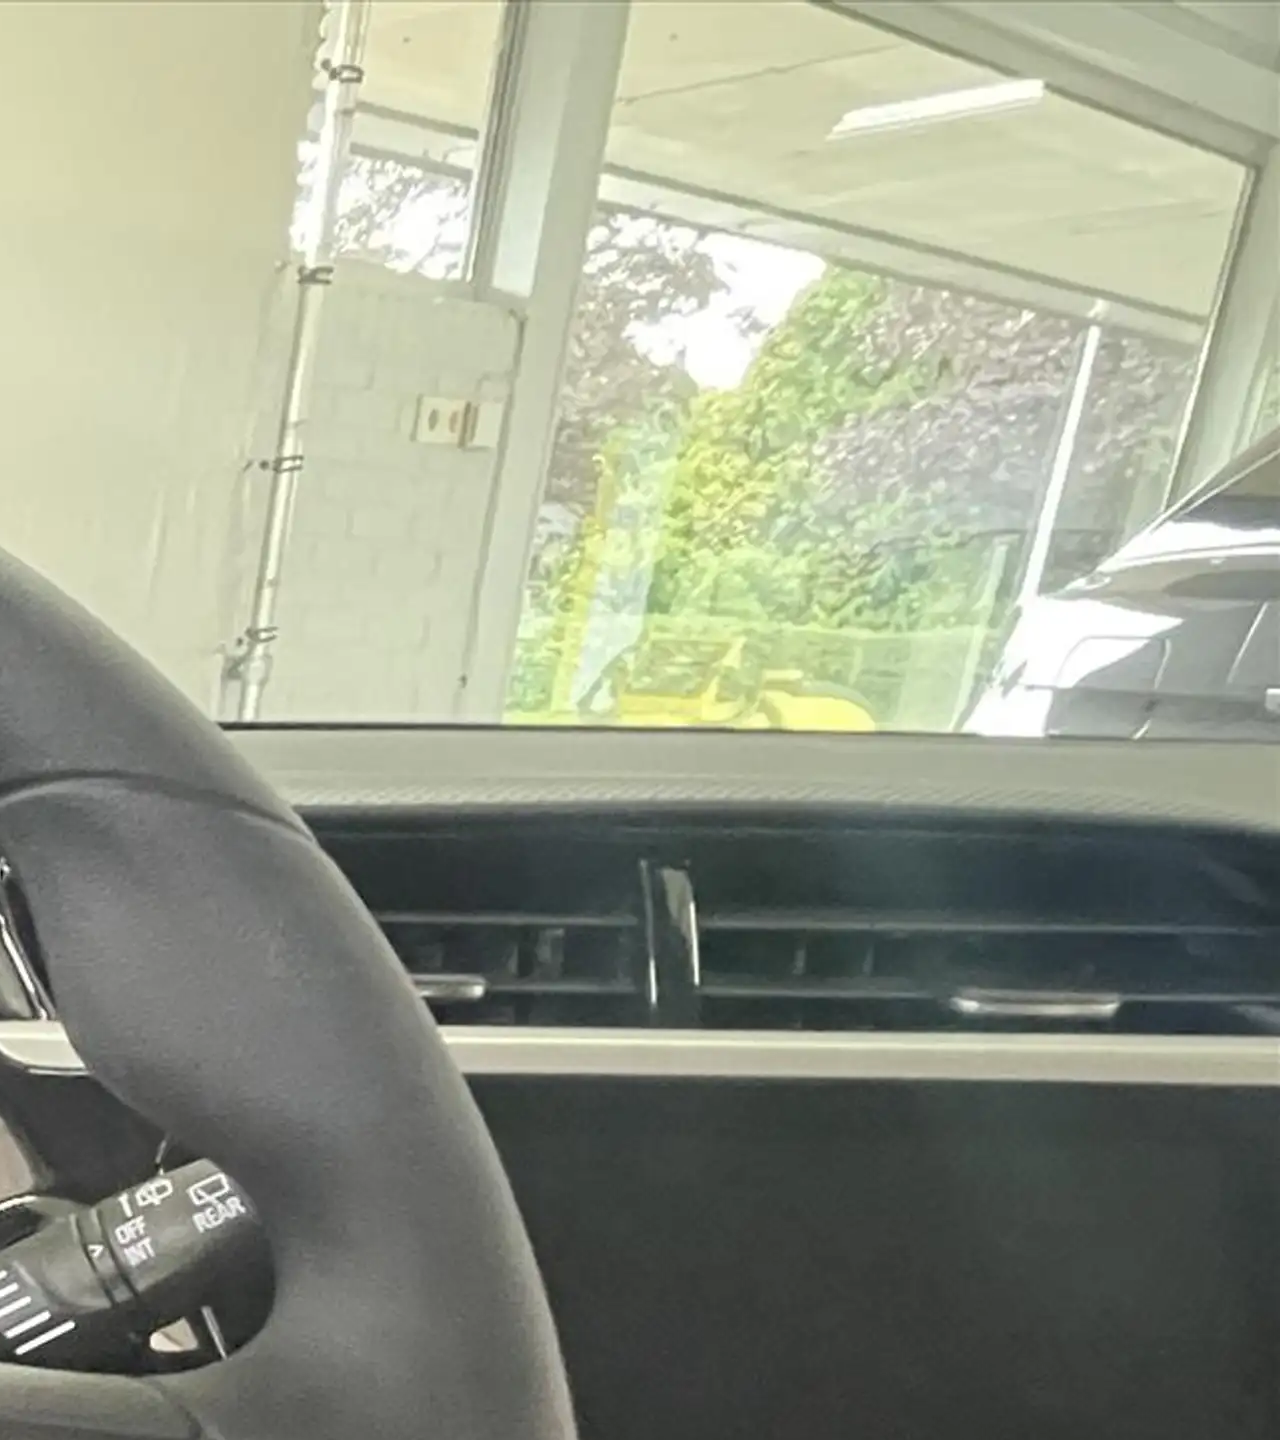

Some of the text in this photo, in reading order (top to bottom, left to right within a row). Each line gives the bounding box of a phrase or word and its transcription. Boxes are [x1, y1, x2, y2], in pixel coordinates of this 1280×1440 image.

[115, 1215, 146, 1244] OFF
[192, 1196, 246, 1234] REAR
[124, 1237, 155, 1267] INT
